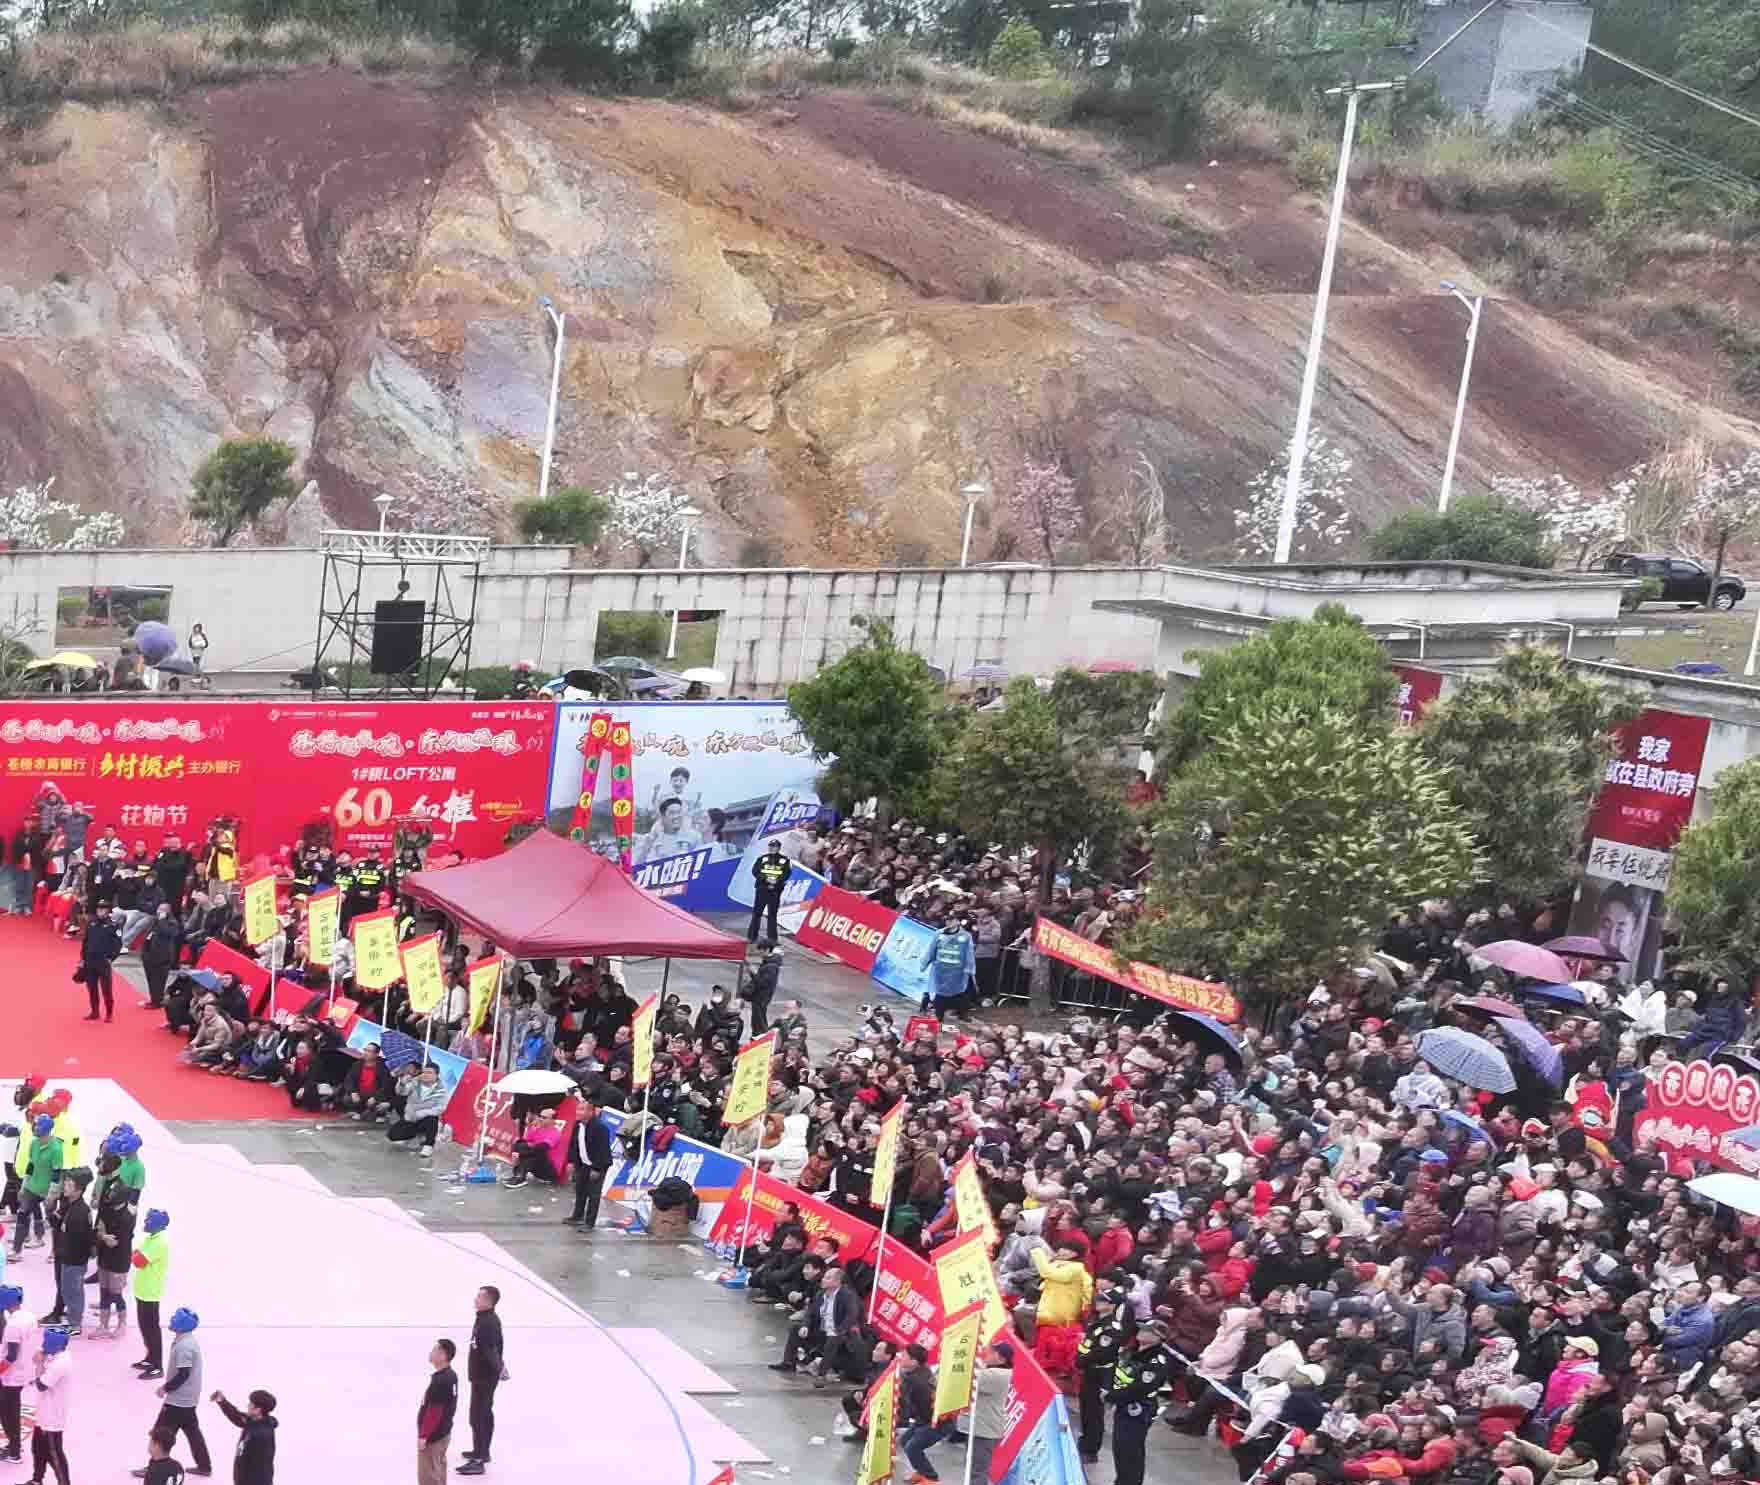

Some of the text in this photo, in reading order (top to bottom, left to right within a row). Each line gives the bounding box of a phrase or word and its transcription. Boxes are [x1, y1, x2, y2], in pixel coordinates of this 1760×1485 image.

[1638, 736, 1672, 762] 我家
[98, 752, 184, 780] 乡村振兴
[335, 787, 394, 828] 60
